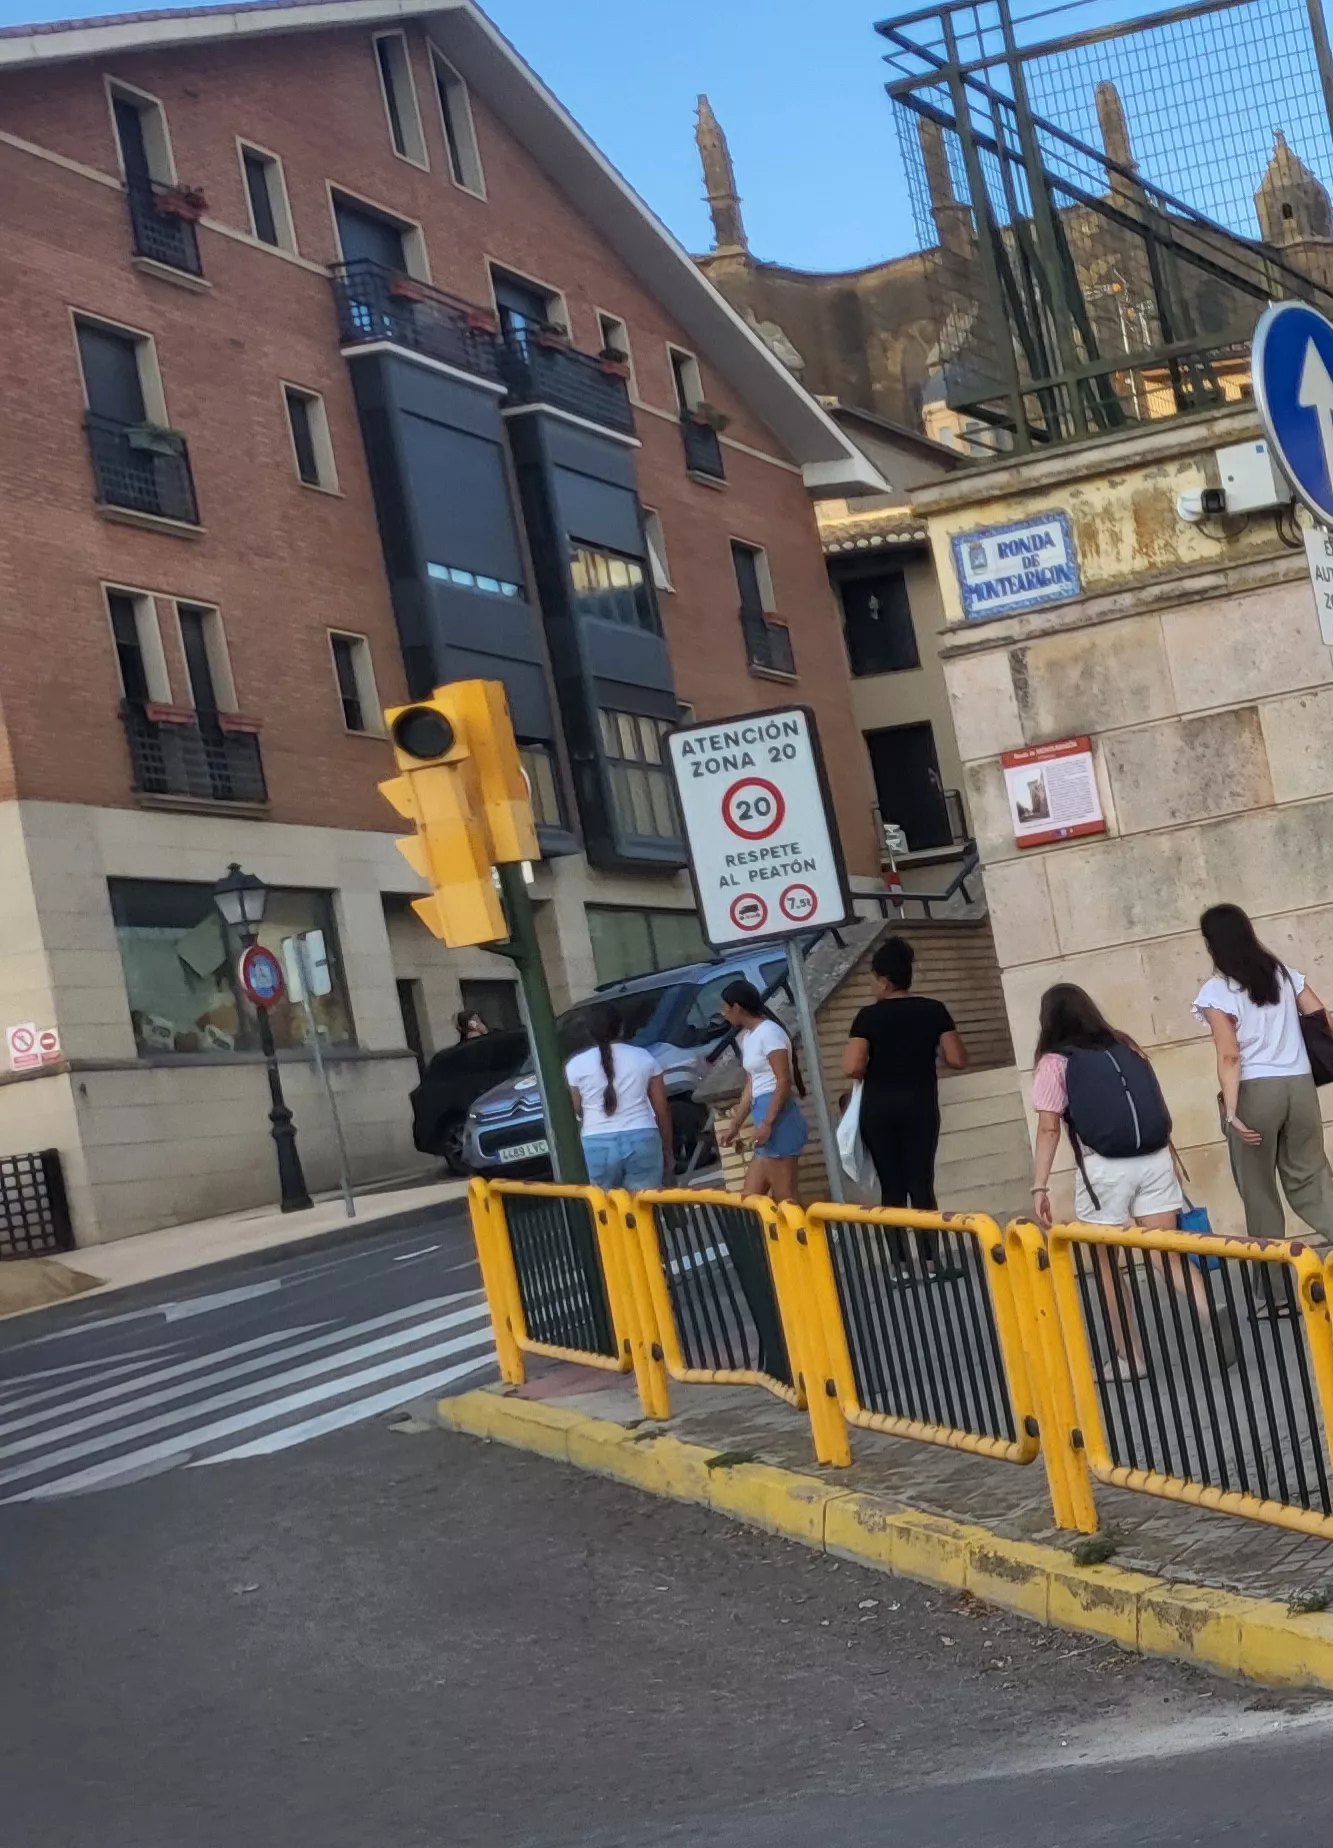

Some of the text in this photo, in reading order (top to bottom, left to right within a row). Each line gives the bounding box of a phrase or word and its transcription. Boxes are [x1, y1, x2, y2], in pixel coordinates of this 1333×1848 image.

[996, 531, 1056, 560] RONDA
[1021, 554, 1041, 569] DE
[681, 719, 799, 758] ATENCIÓN
[691, 743, 797, 778] ZONA 20
[735, 796, 772, 821] 20
[724, 841, 802, 868] RESPETE
[719, 858, 817, 888] AL PEATÓN
